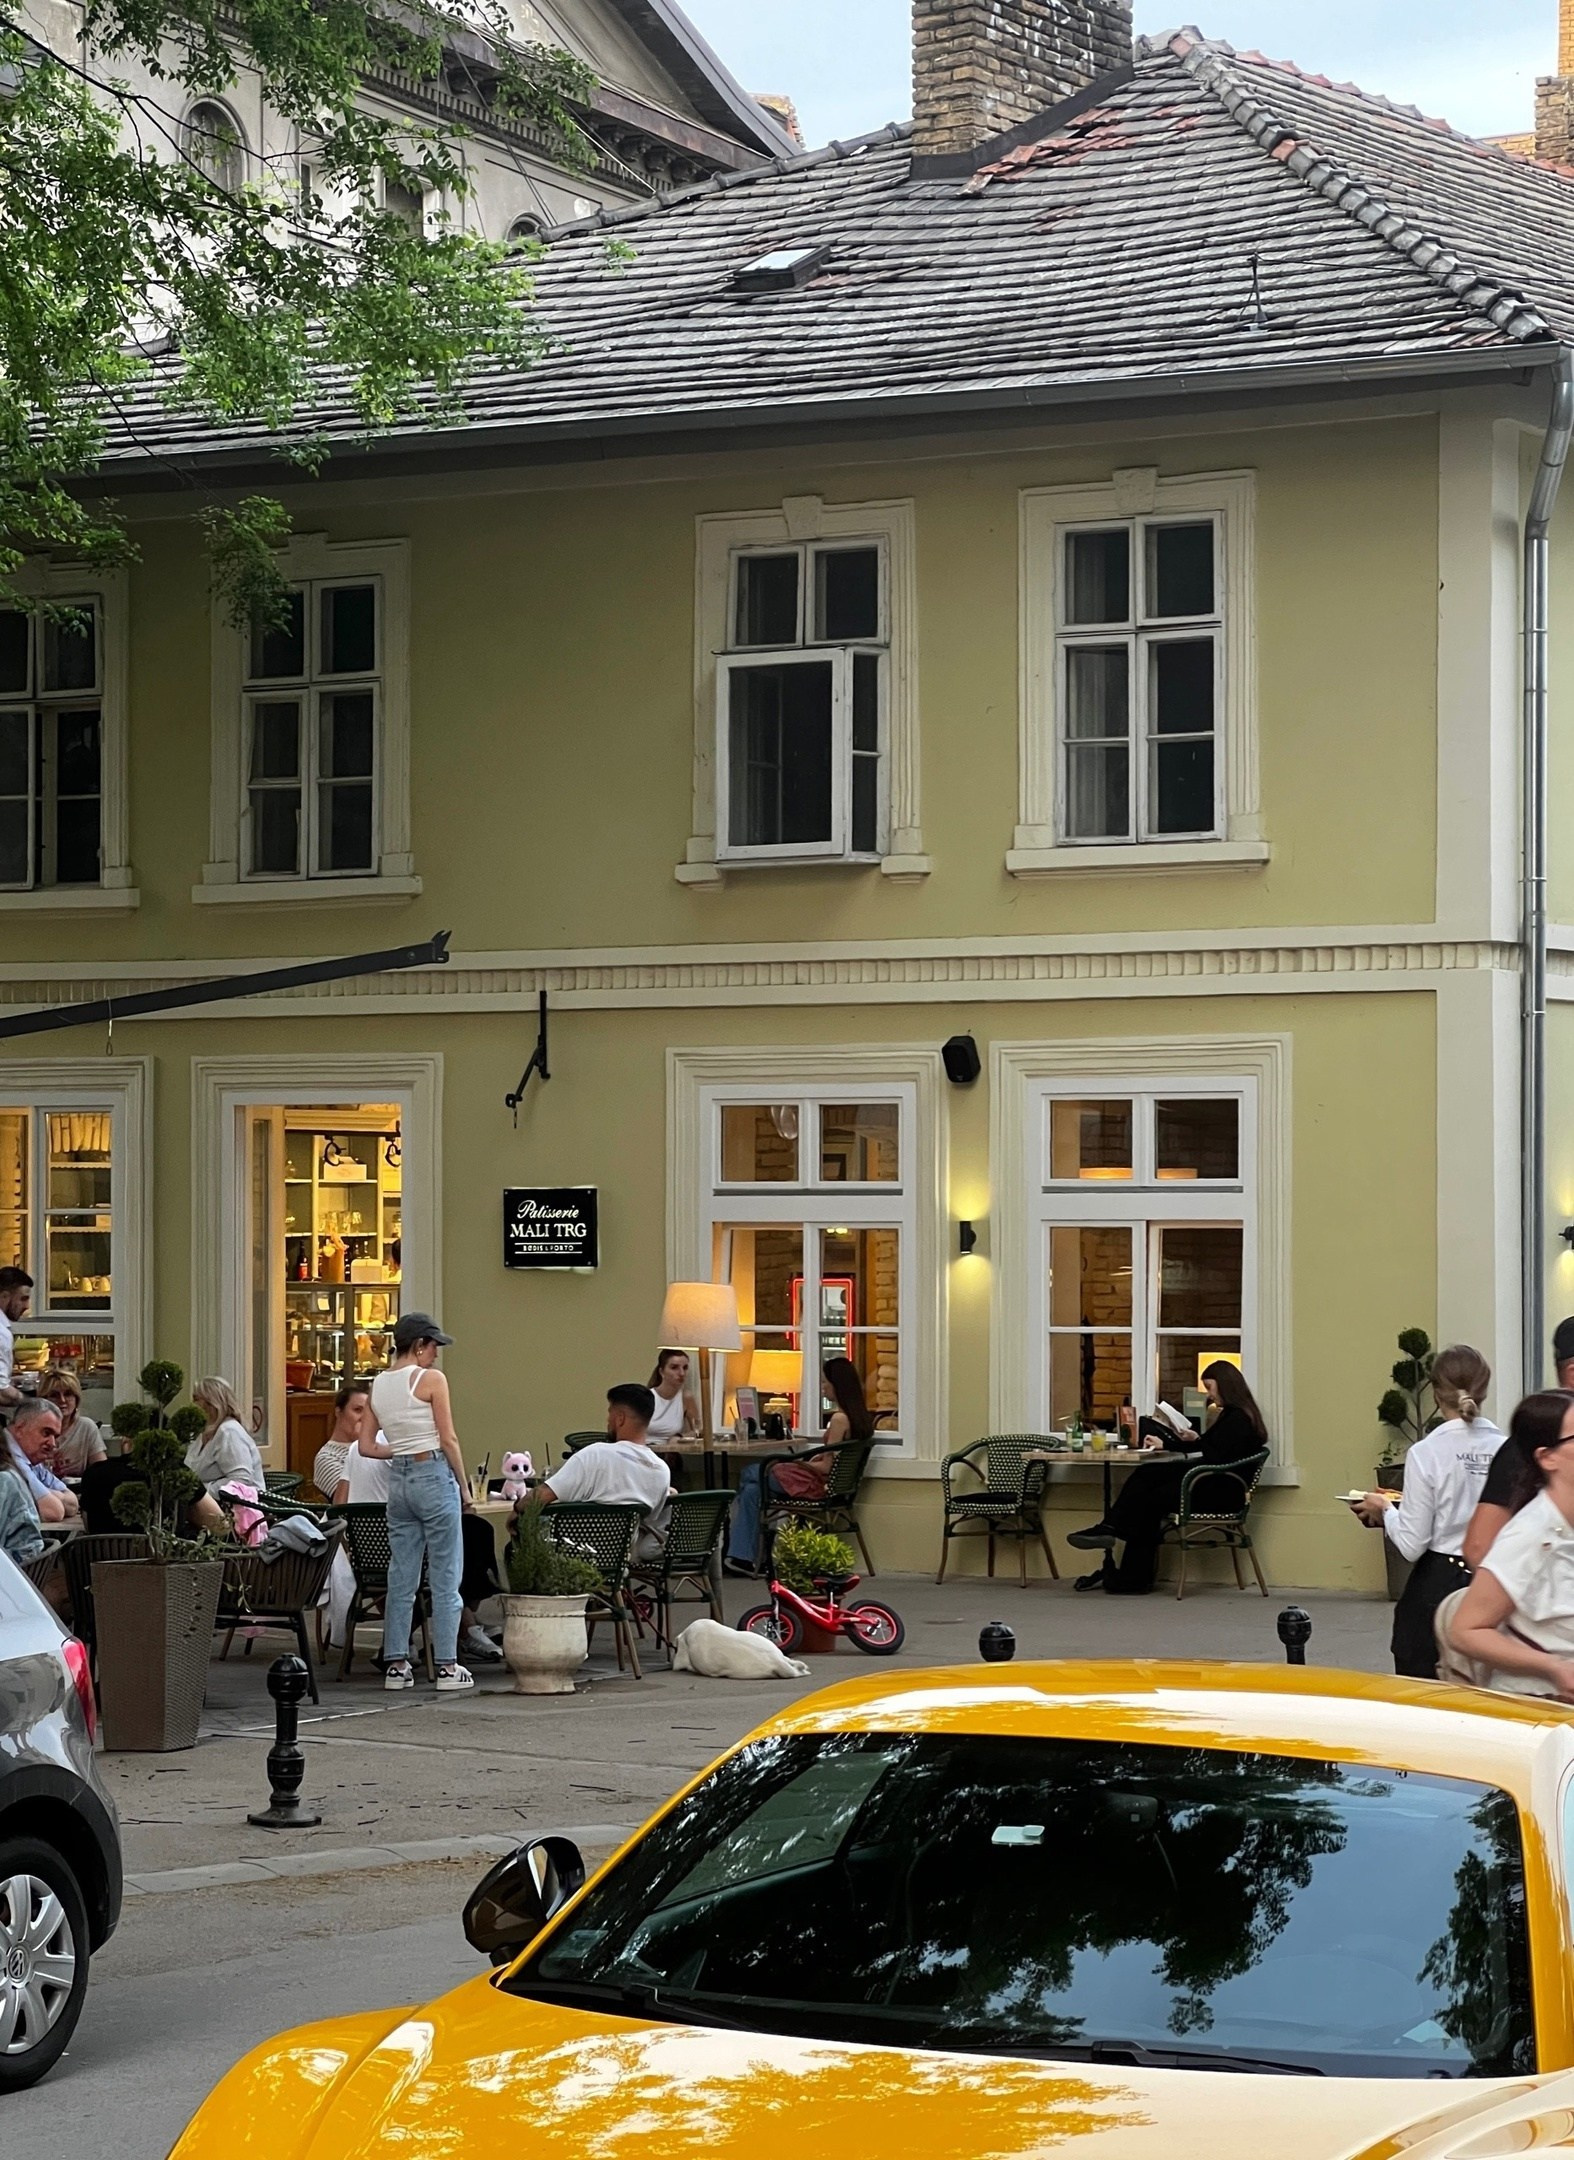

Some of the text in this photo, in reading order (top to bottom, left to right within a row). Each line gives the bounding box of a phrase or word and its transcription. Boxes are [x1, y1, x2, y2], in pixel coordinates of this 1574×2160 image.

[517, 1200, 579, 1219] Patisserie
[510, 1223, 587, 1238] MALI TRG
